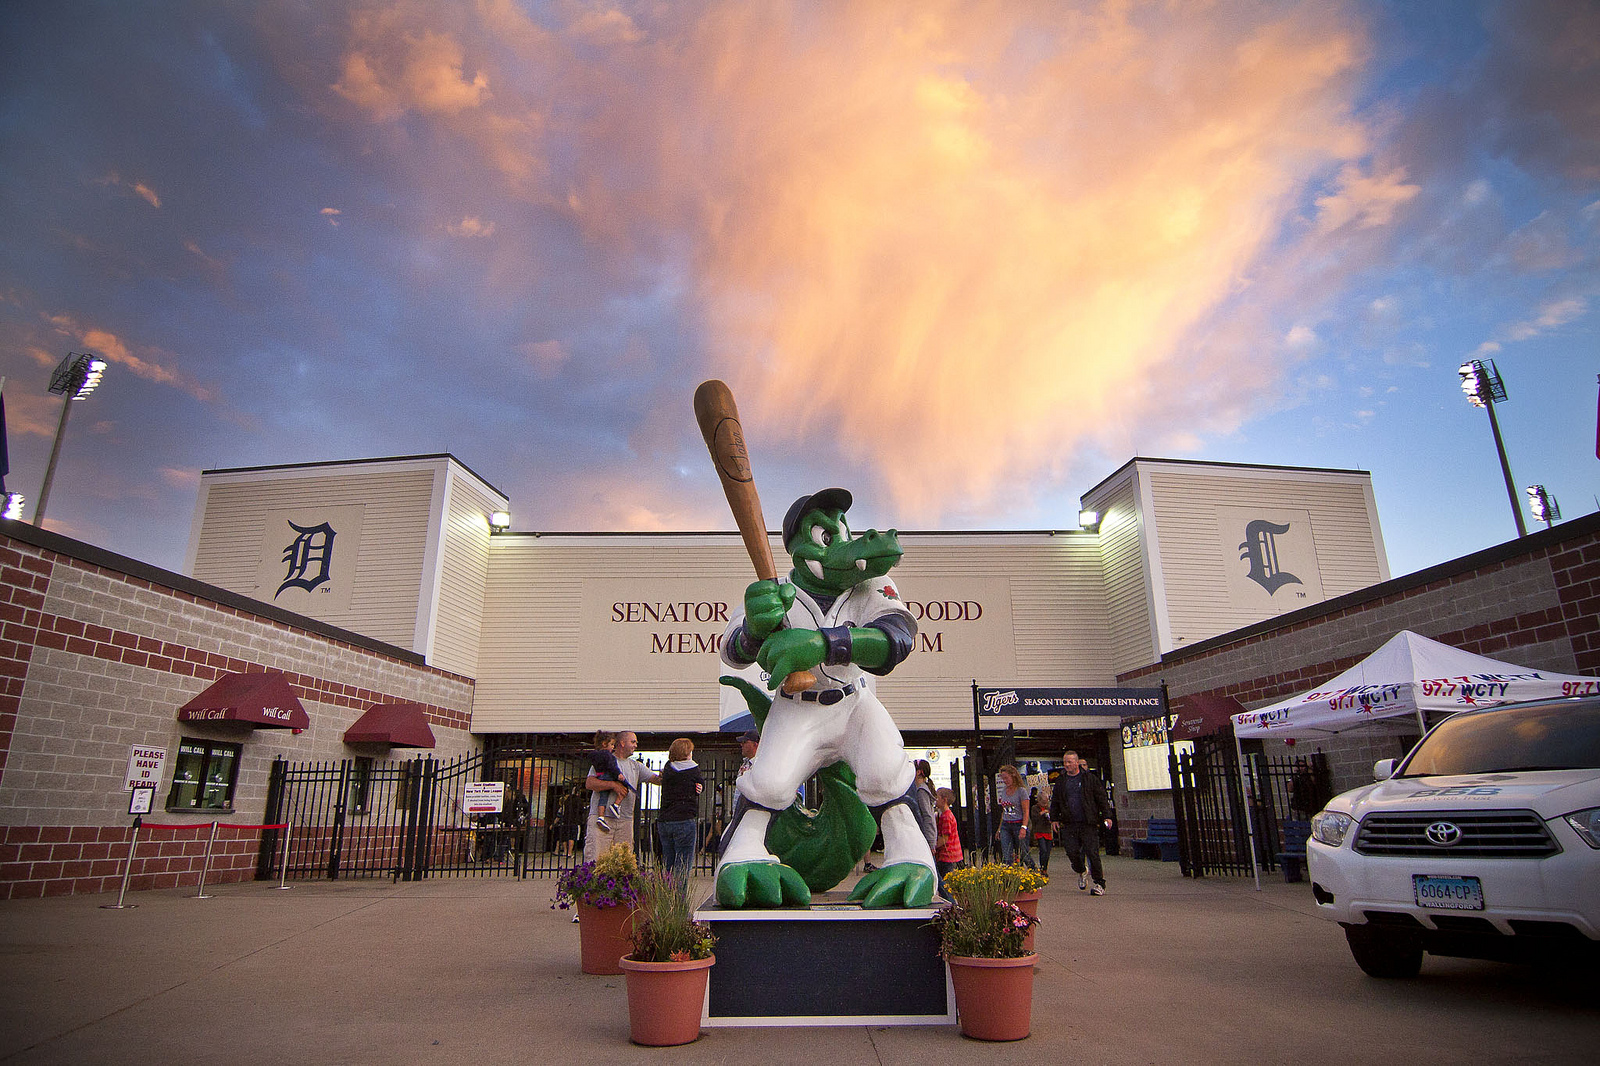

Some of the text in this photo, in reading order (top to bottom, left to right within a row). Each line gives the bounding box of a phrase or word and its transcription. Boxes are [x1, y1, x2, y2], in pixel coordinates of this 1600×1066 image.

[274, 519, 337, 601] D
[611, 600, 983, 623] SENATOR DODD
[1422, 682, 1509, 697] 97.7 WCTY
[1562, 681, 1595, 696] 97.7
[983, 690, 1019, 714] Tigers
[1024, 698, 1160, 706] SEASON TICKET HOLDERS ENTRANCE
[1328, 693, 1355, 711] 97.7
[1357, 685, 1401, 705] WCTY
[188, 707, 229, 720] Will Call
[263, 706, 293, 721] Will Call
[1259, 707, 1291, 722] WCTY
[133, 749, 165, 760] PLEASE
[180, 745, 205, 755] WILL CALL
[211, 749, 234, 758] WILL CALL
[136, 760, 159, 769] HAVE
[141, 770, 151, 778] ID
[129, 780, 158, 788] READY
[1425, 902, 1474, 910] WALLINGFORD
